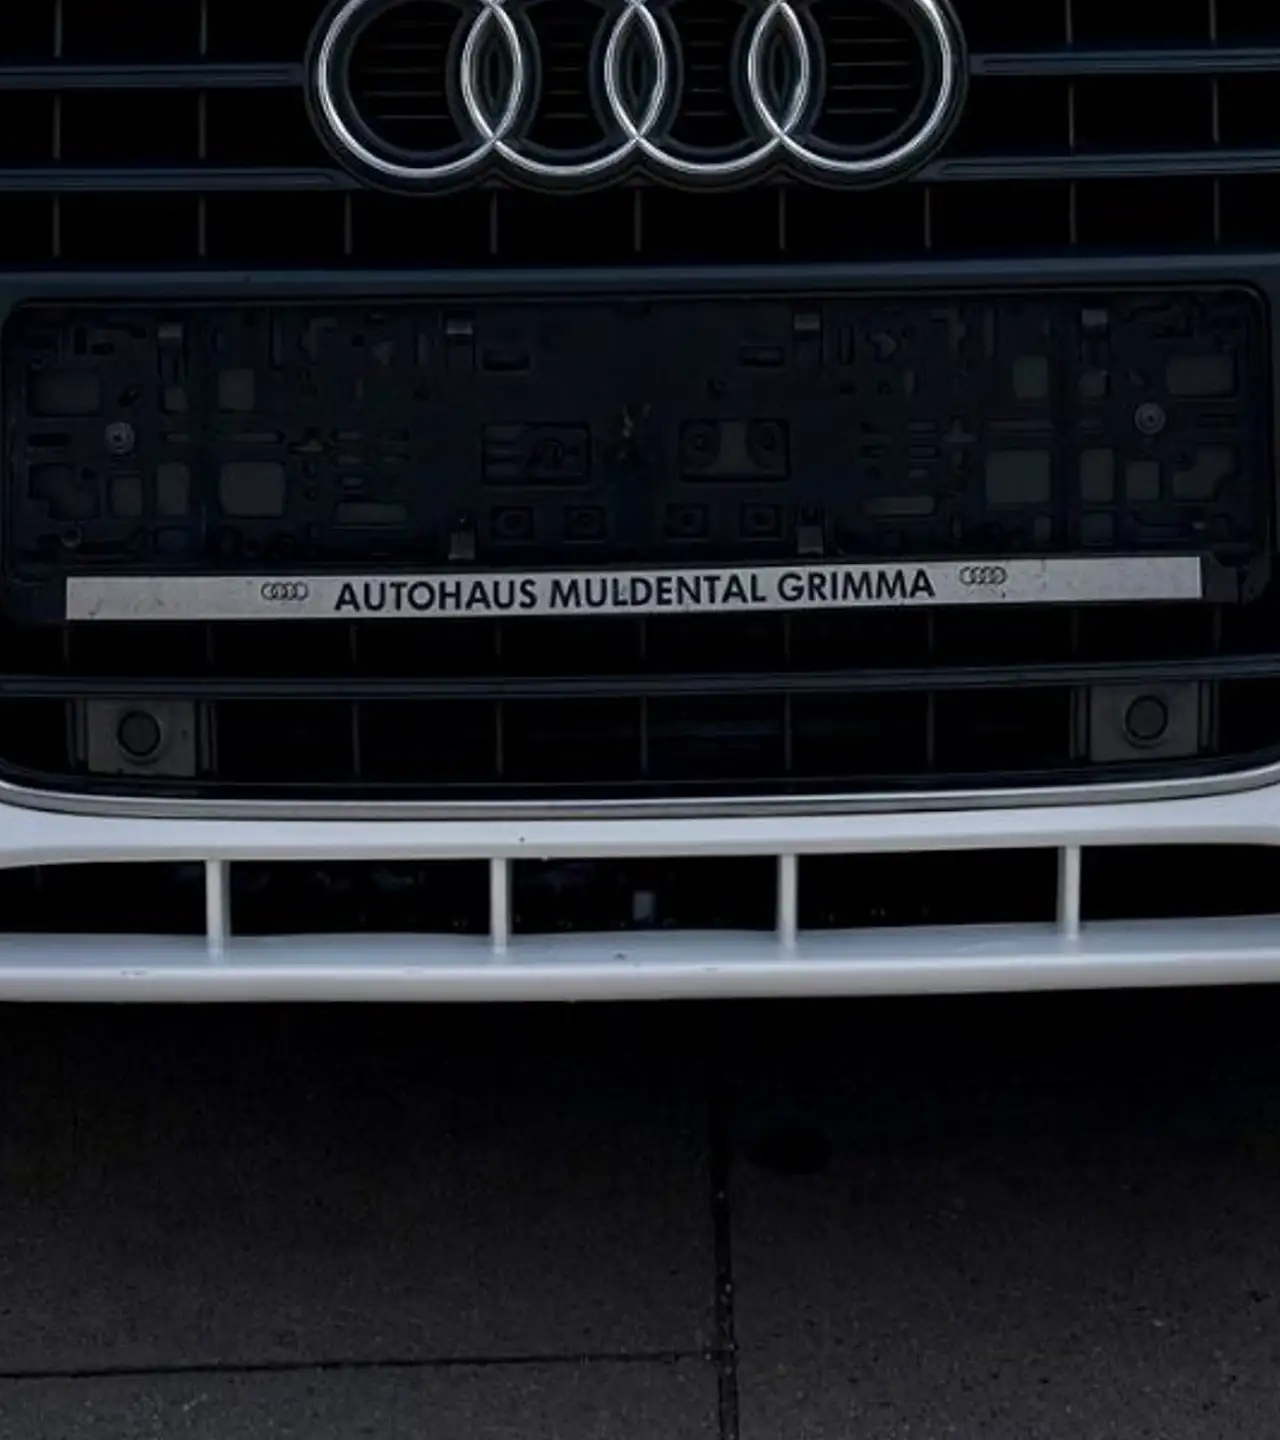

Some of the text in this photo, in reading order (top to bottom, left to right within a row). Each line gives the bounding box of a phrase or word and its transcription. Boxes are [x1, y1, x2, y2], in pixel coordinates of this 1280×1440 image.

[334, 568, 936, 613] AUTOHAUS MULDENTAL GRIMMA
